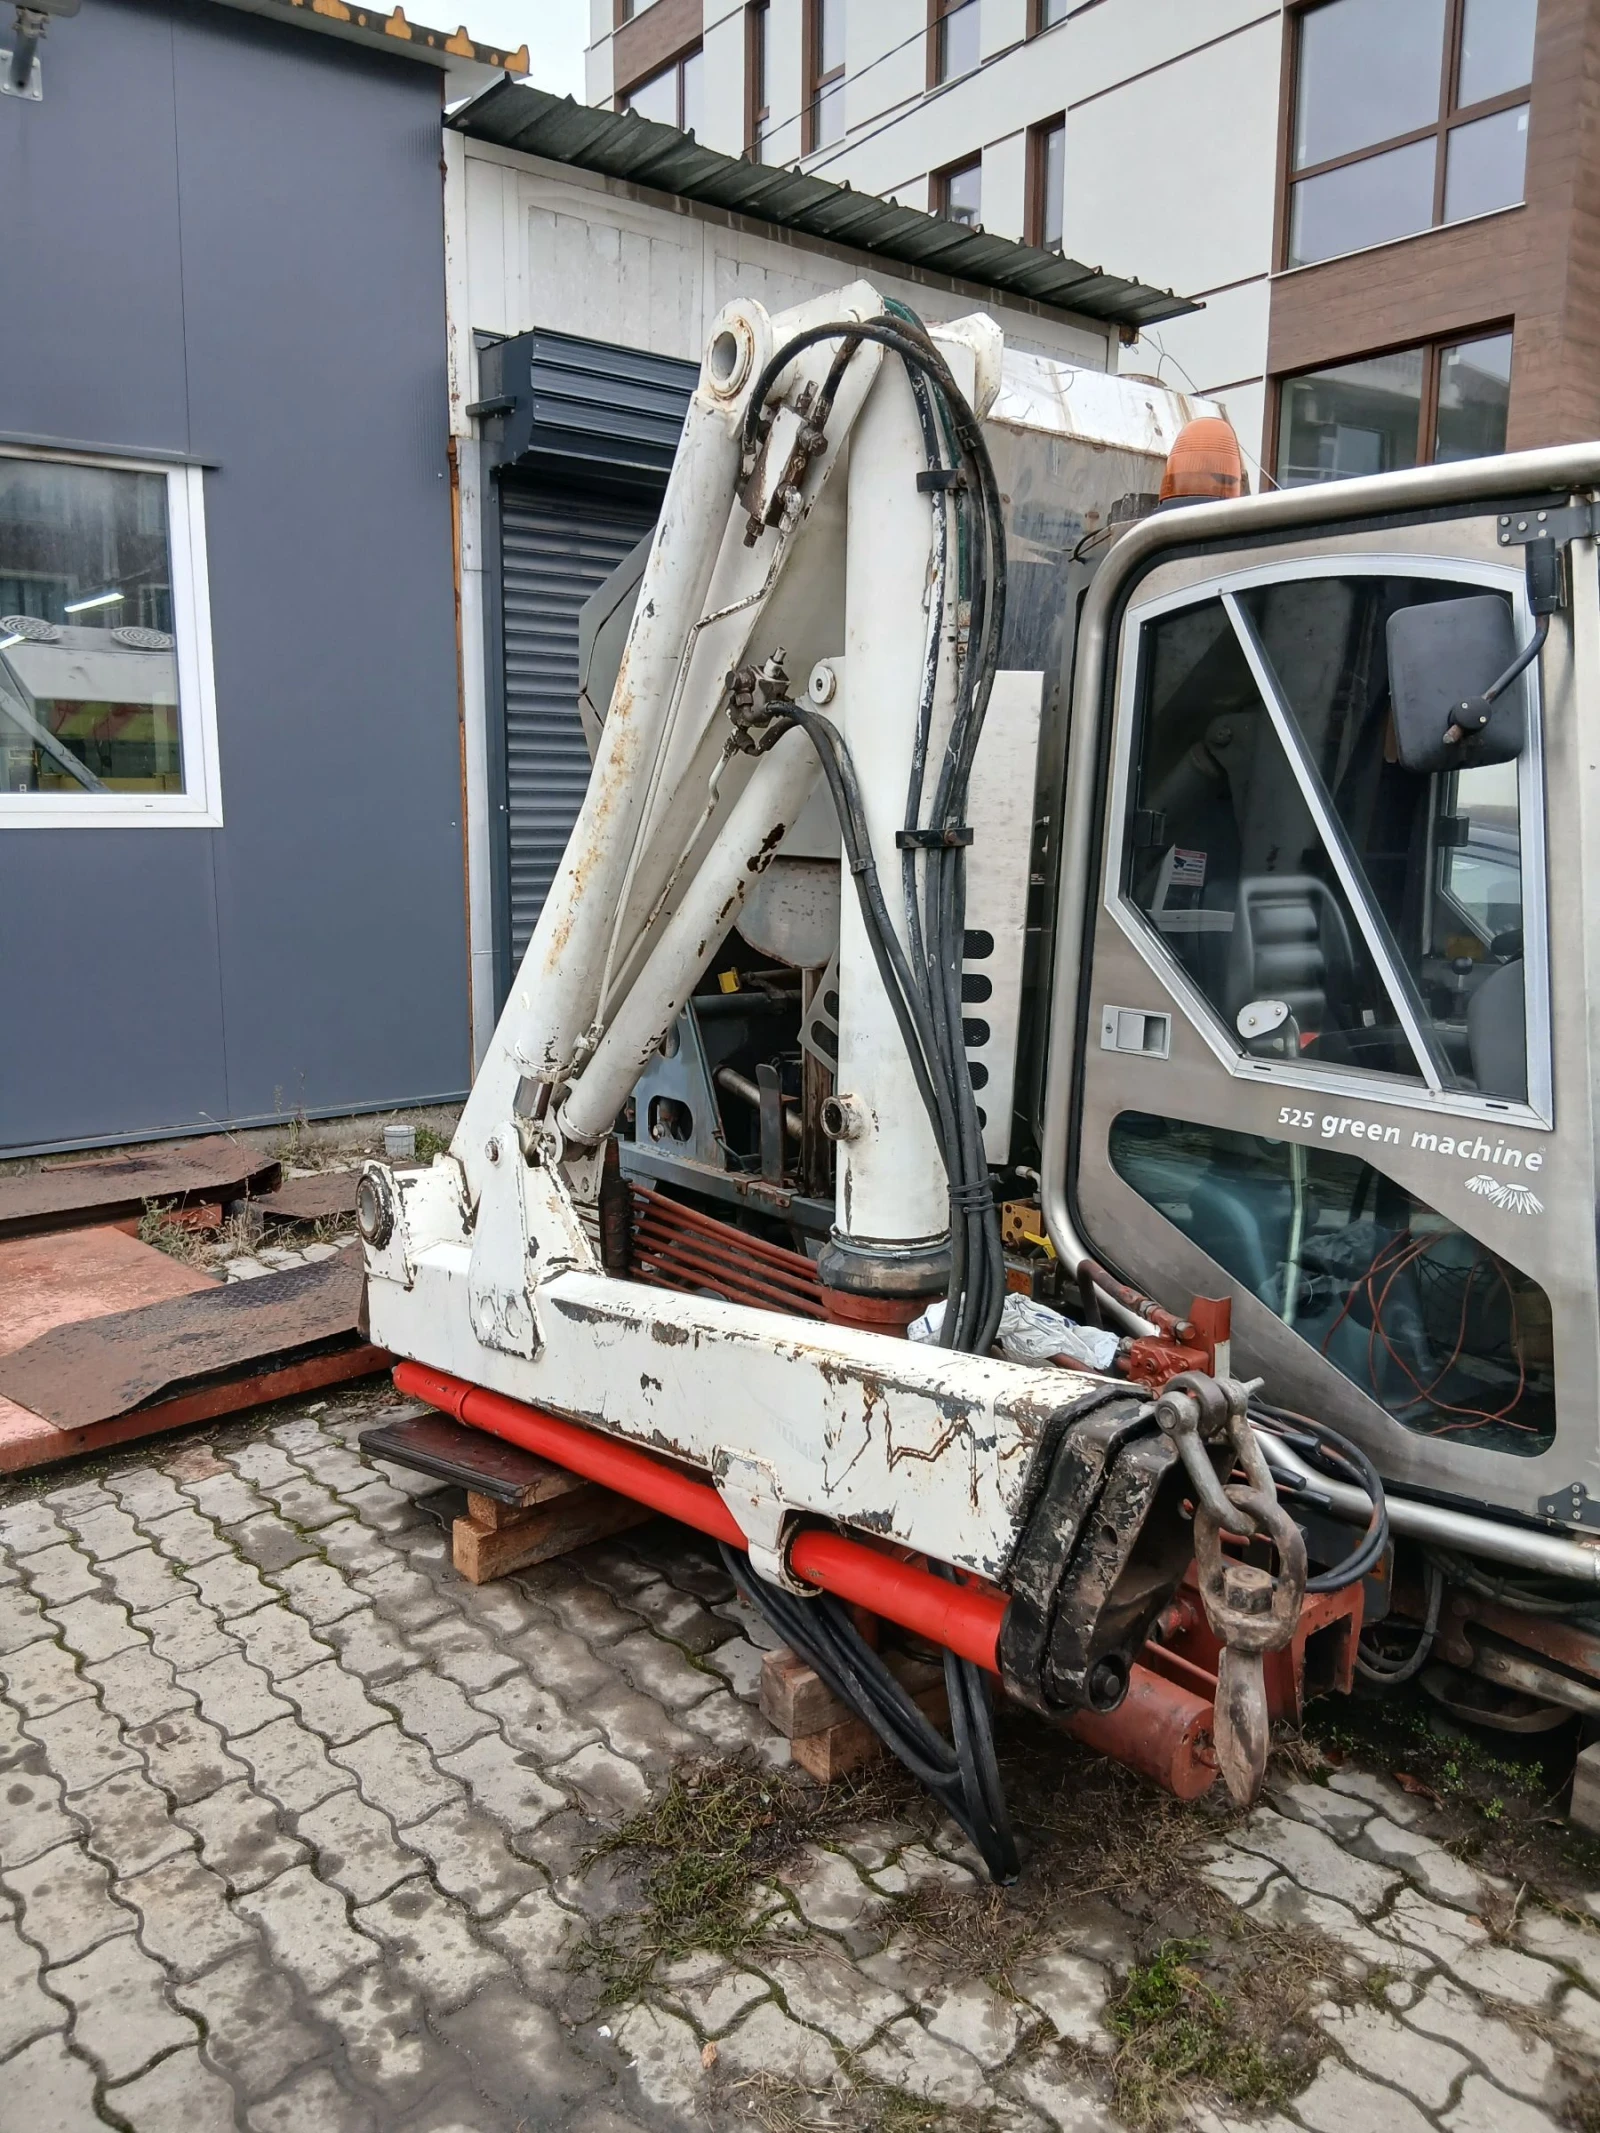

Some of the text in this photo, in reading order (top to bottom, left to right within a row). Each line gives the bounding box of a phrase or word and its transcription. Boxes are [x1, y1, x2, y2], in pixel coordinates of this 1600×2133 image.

[1278, 1107, 1543, 1171] 525 green machine
